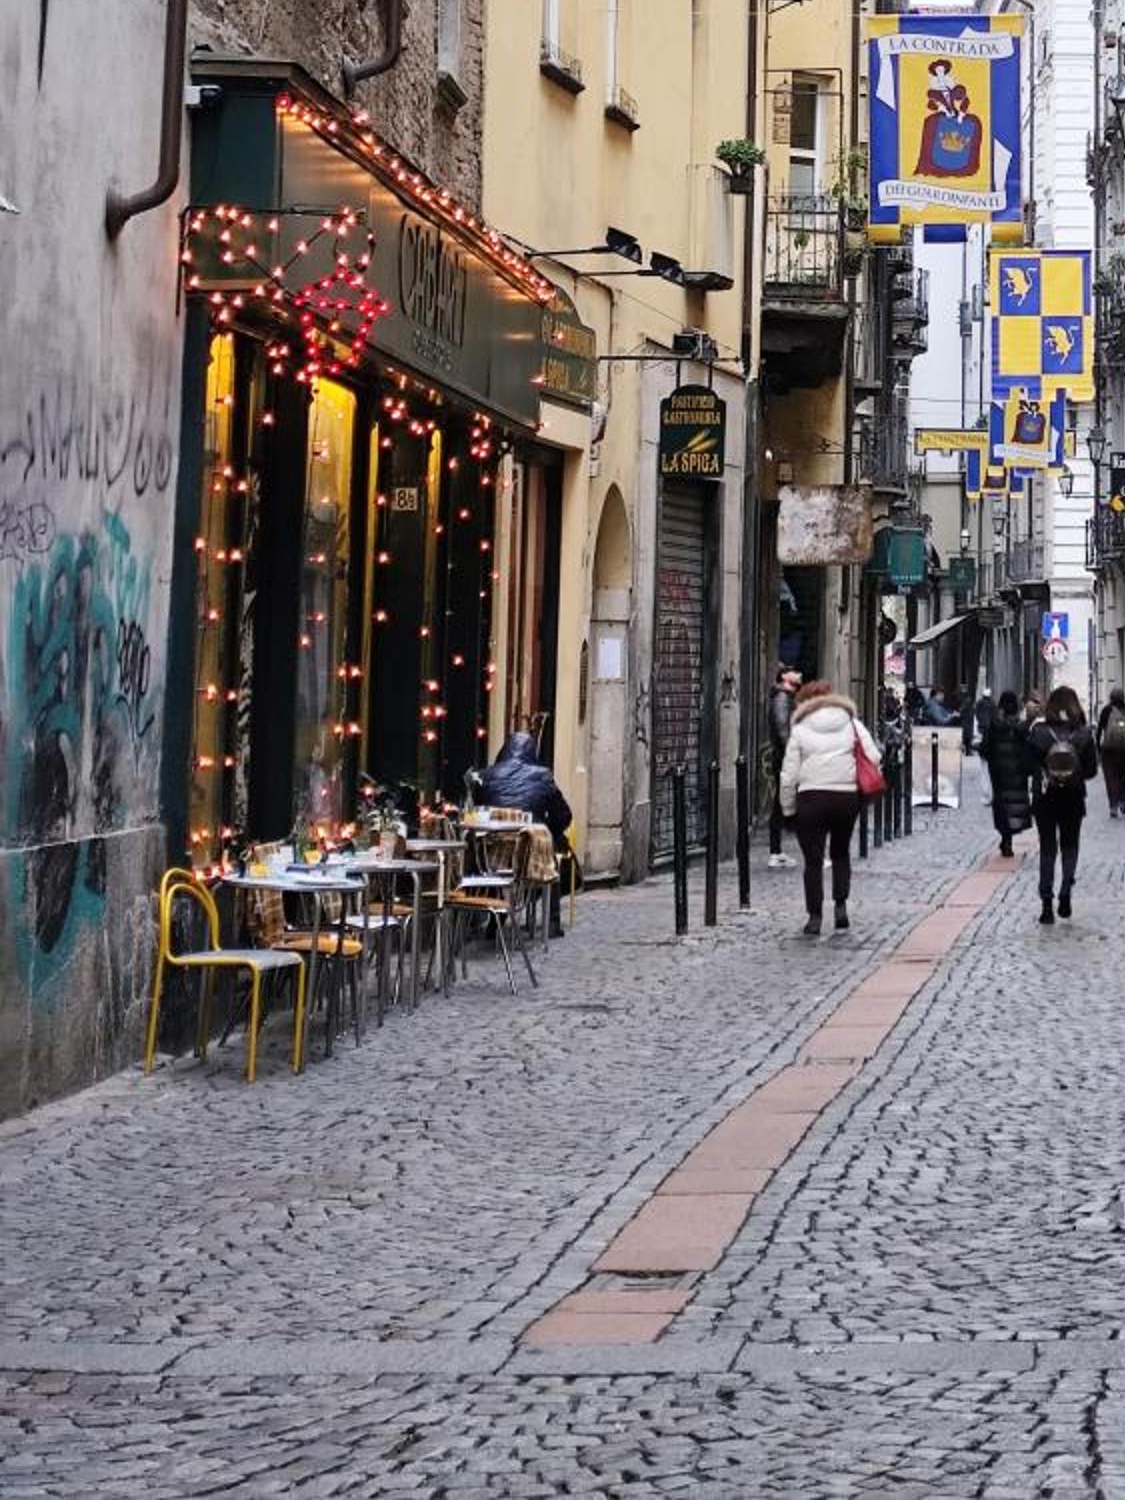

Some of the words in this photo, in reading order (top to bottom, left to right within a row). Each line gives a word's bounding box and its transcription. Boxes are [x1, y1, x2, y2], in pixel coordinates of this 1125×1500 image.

[889, 37, 908, 51] LA
[911, 37, 1000, 55] CONTRADA
[661, 452, 679, 473] LA
[681, 452, 720, 473] SPIGA
